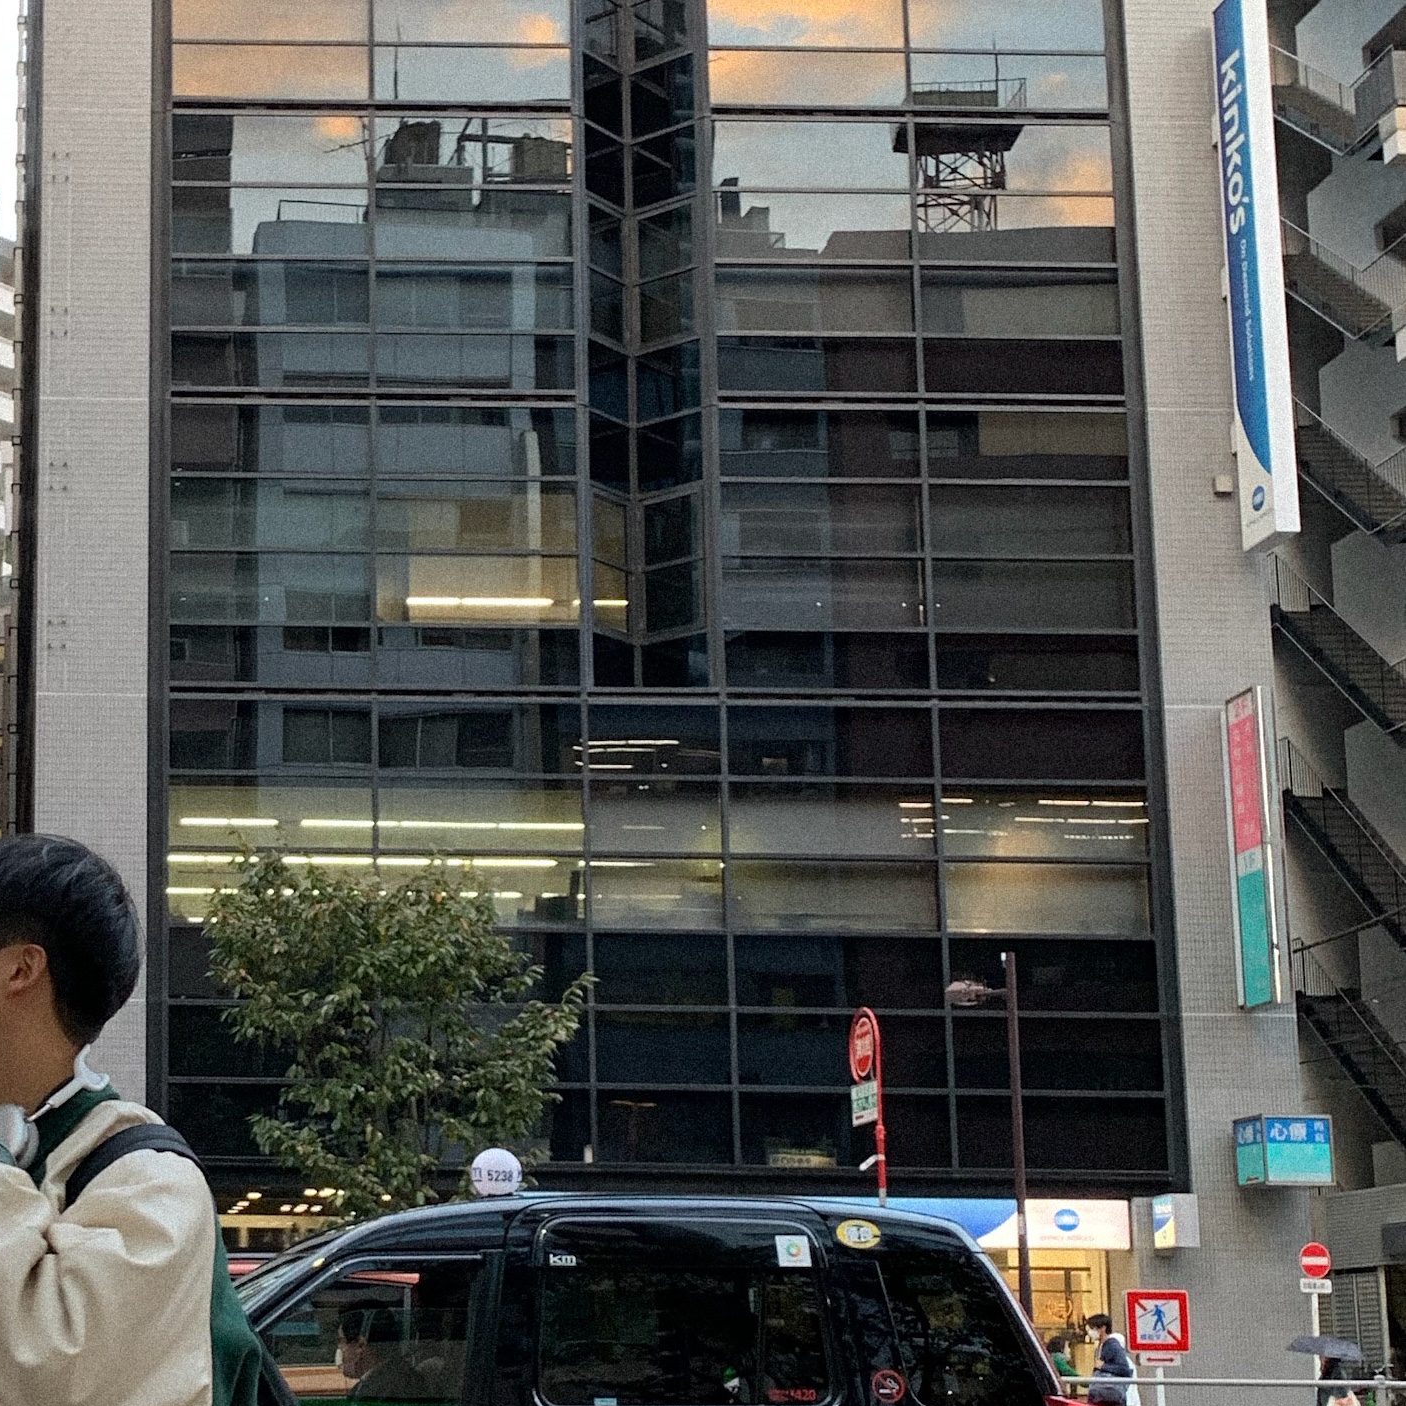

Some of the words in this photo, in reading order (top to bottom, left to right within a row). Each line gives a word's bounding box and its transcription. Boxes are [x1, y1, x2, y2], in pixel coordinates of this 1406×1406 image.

[1220, 49, 1250, 235] kinko's
[487, 1169, 514, 1182] 5238
[549, 1253, 577, 1267] km
